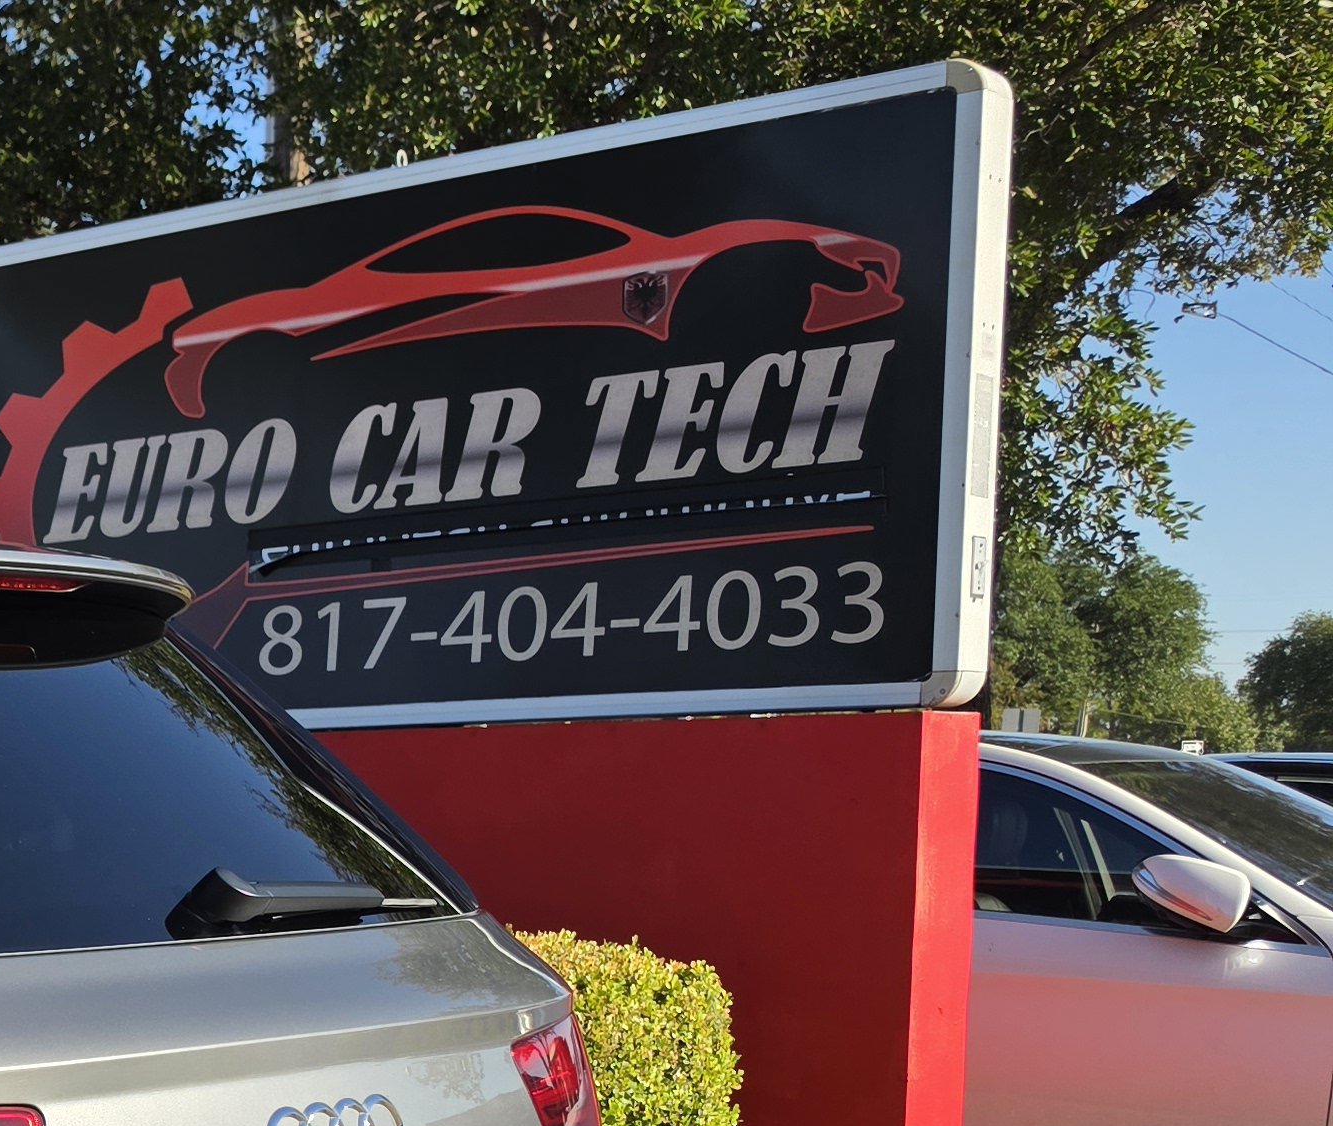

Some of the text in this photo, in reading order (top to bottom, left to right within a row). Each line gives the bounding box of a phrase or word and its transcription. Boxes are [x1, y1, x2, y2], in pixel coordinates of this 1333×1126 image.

[42, 417, 296, 546] EURO
[329, 387, 541, 515] CAR
[575, 339, 895, 489] TECH
[258, 560, 885, 676] 817-404-4033
